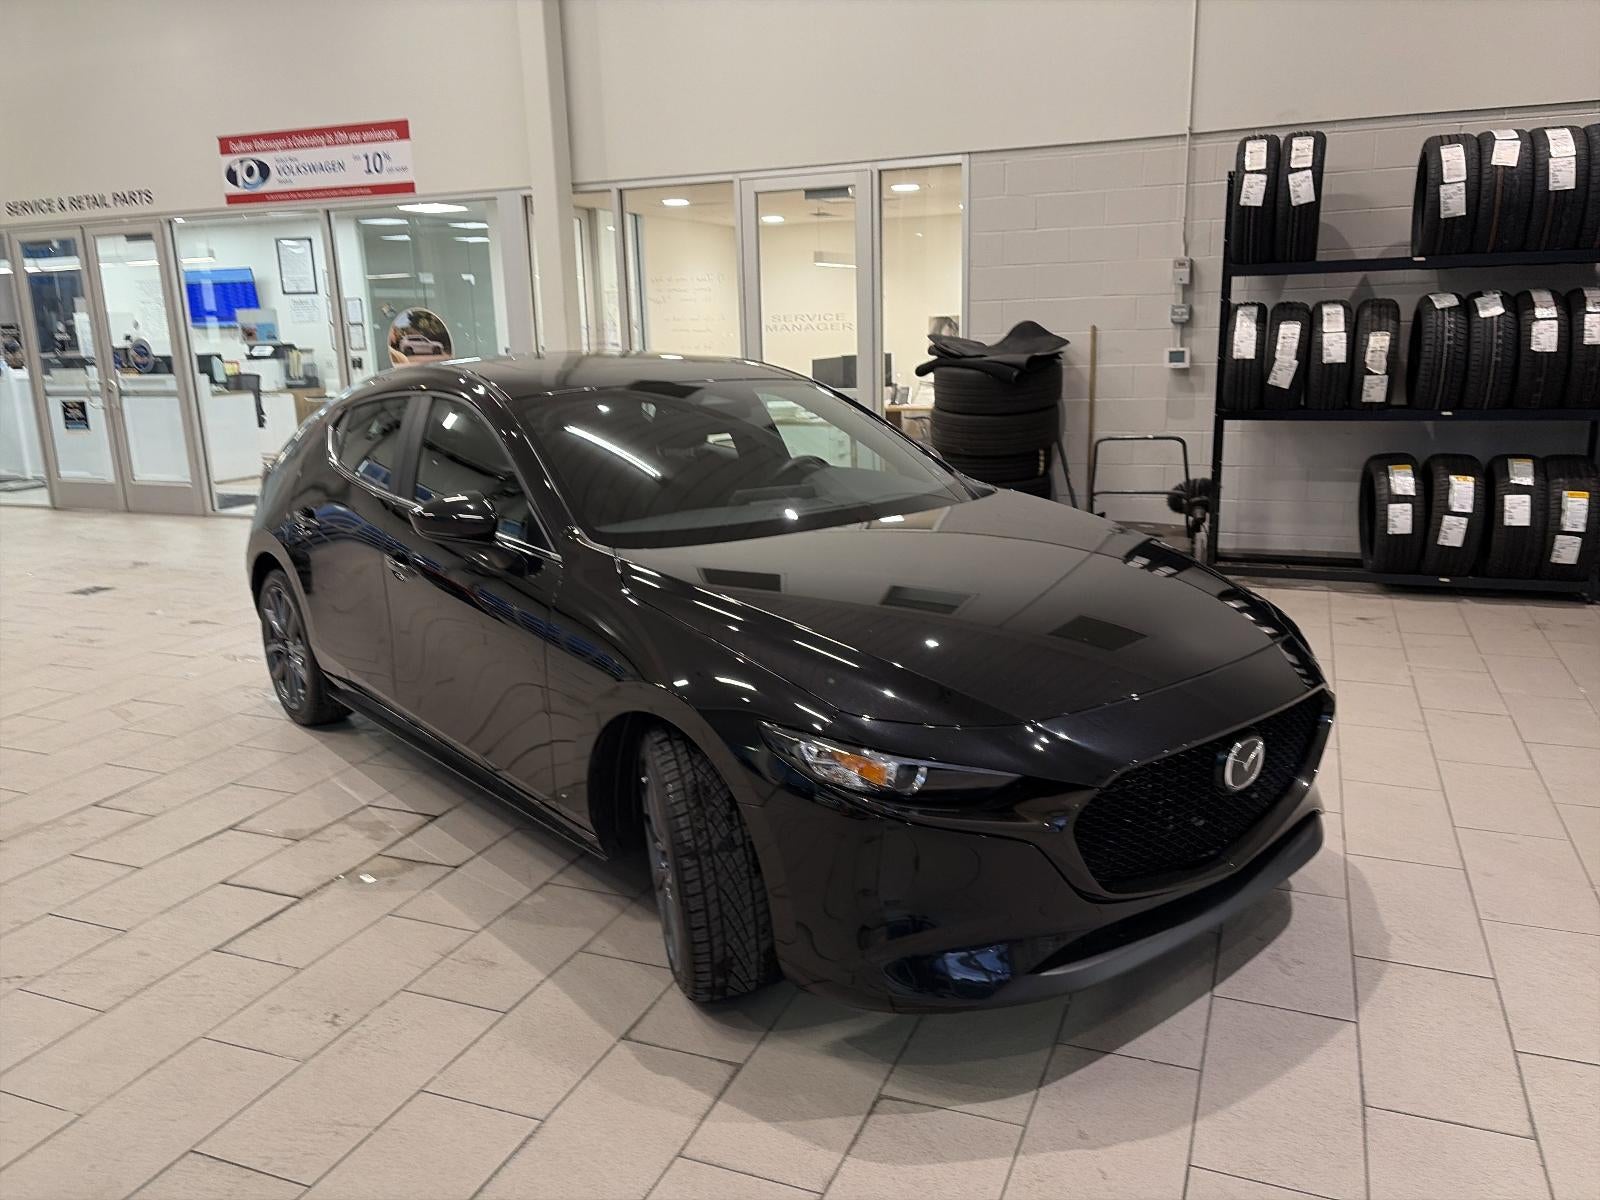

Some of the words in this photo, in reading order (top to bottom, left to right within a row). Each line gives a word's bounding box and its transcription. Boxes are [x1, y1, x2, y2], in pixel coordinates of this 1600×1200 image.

[276, 160, 346, 176] VOLKSWAGEN
[5, 199, 56, 216] SERVICE
[57, 197, 66, 212] &
[68, 193, 110, 211] RETAIL
[112, 189, 154, 207] PARTS
[770, 312, 847, 323] SERVICE
[765, 322, 856, 333] MANAGER
